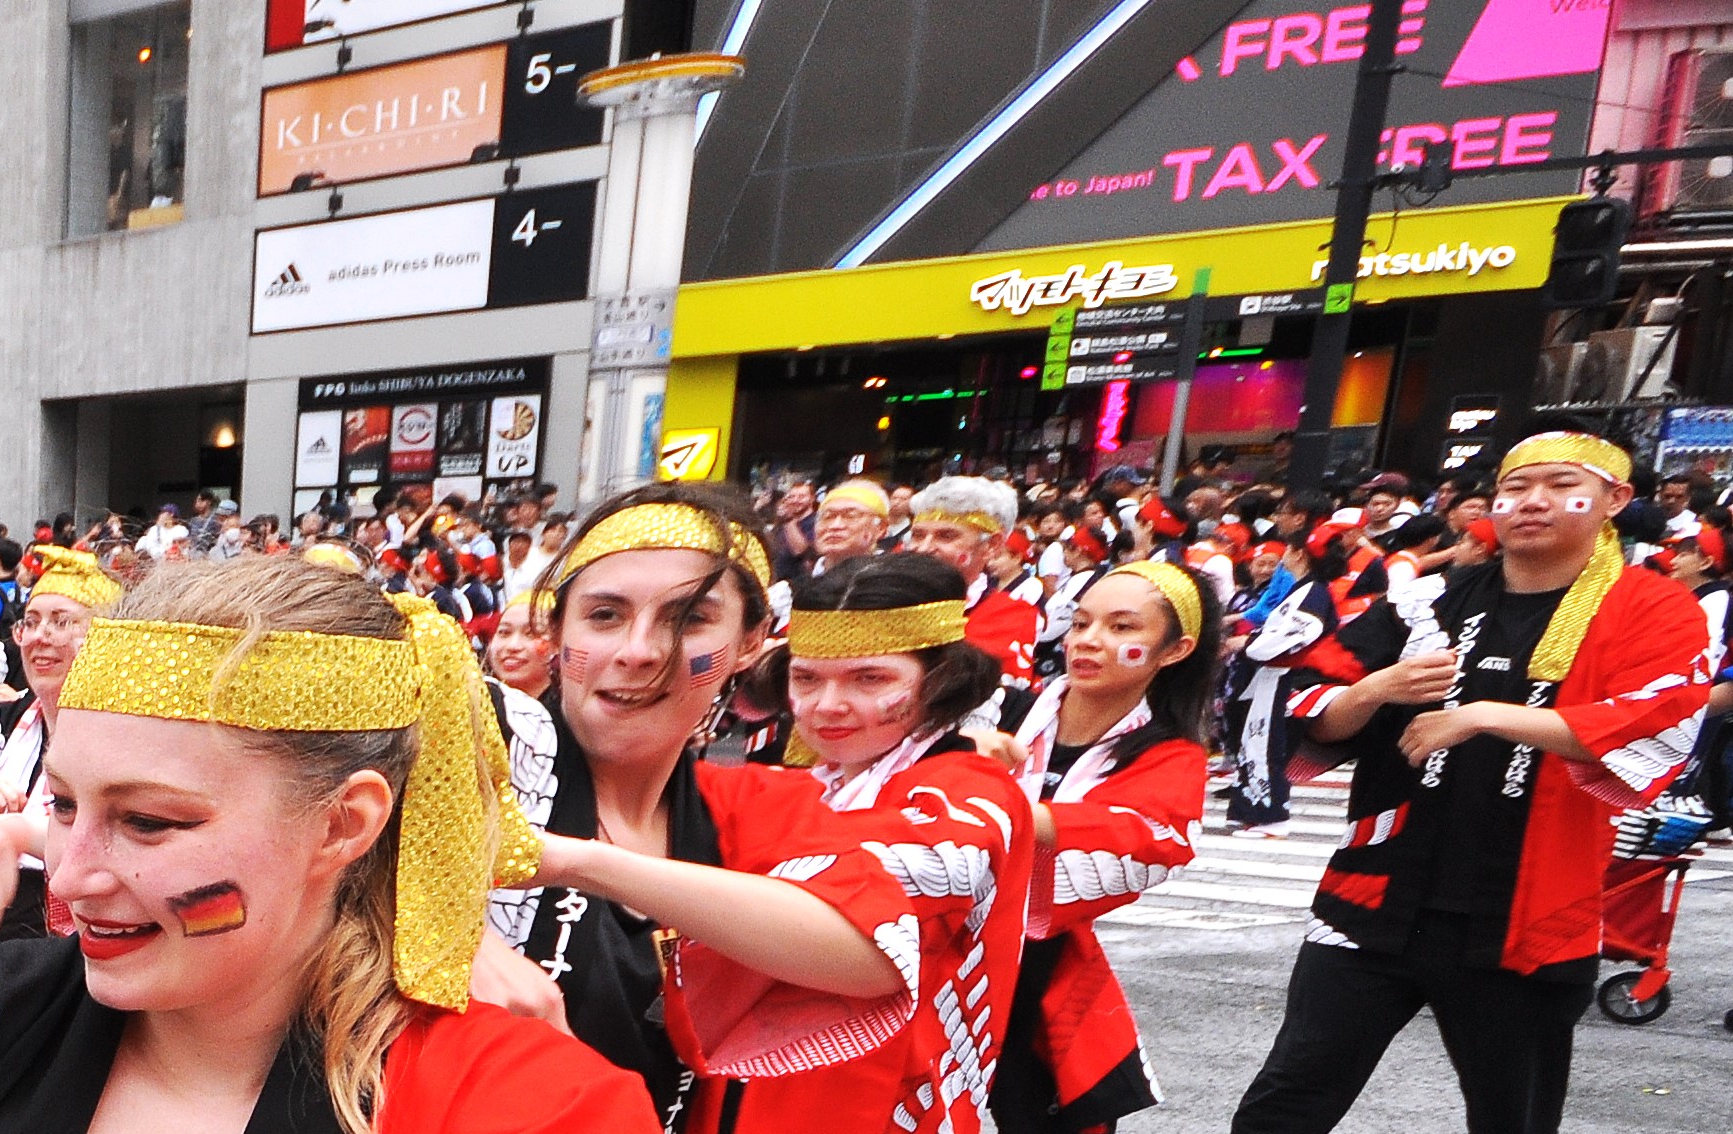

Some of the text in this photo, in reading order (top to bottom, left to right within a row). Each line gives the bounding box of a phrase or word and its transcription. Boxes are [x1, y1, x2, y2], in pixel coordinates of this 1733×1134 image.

[1055, 179, 1080, 199] to
[1083, 167, 1157, 196] Japan!
[1162, 133, 1328, 203] TAX
[328, 250, 482, 282] adidas Press Room
